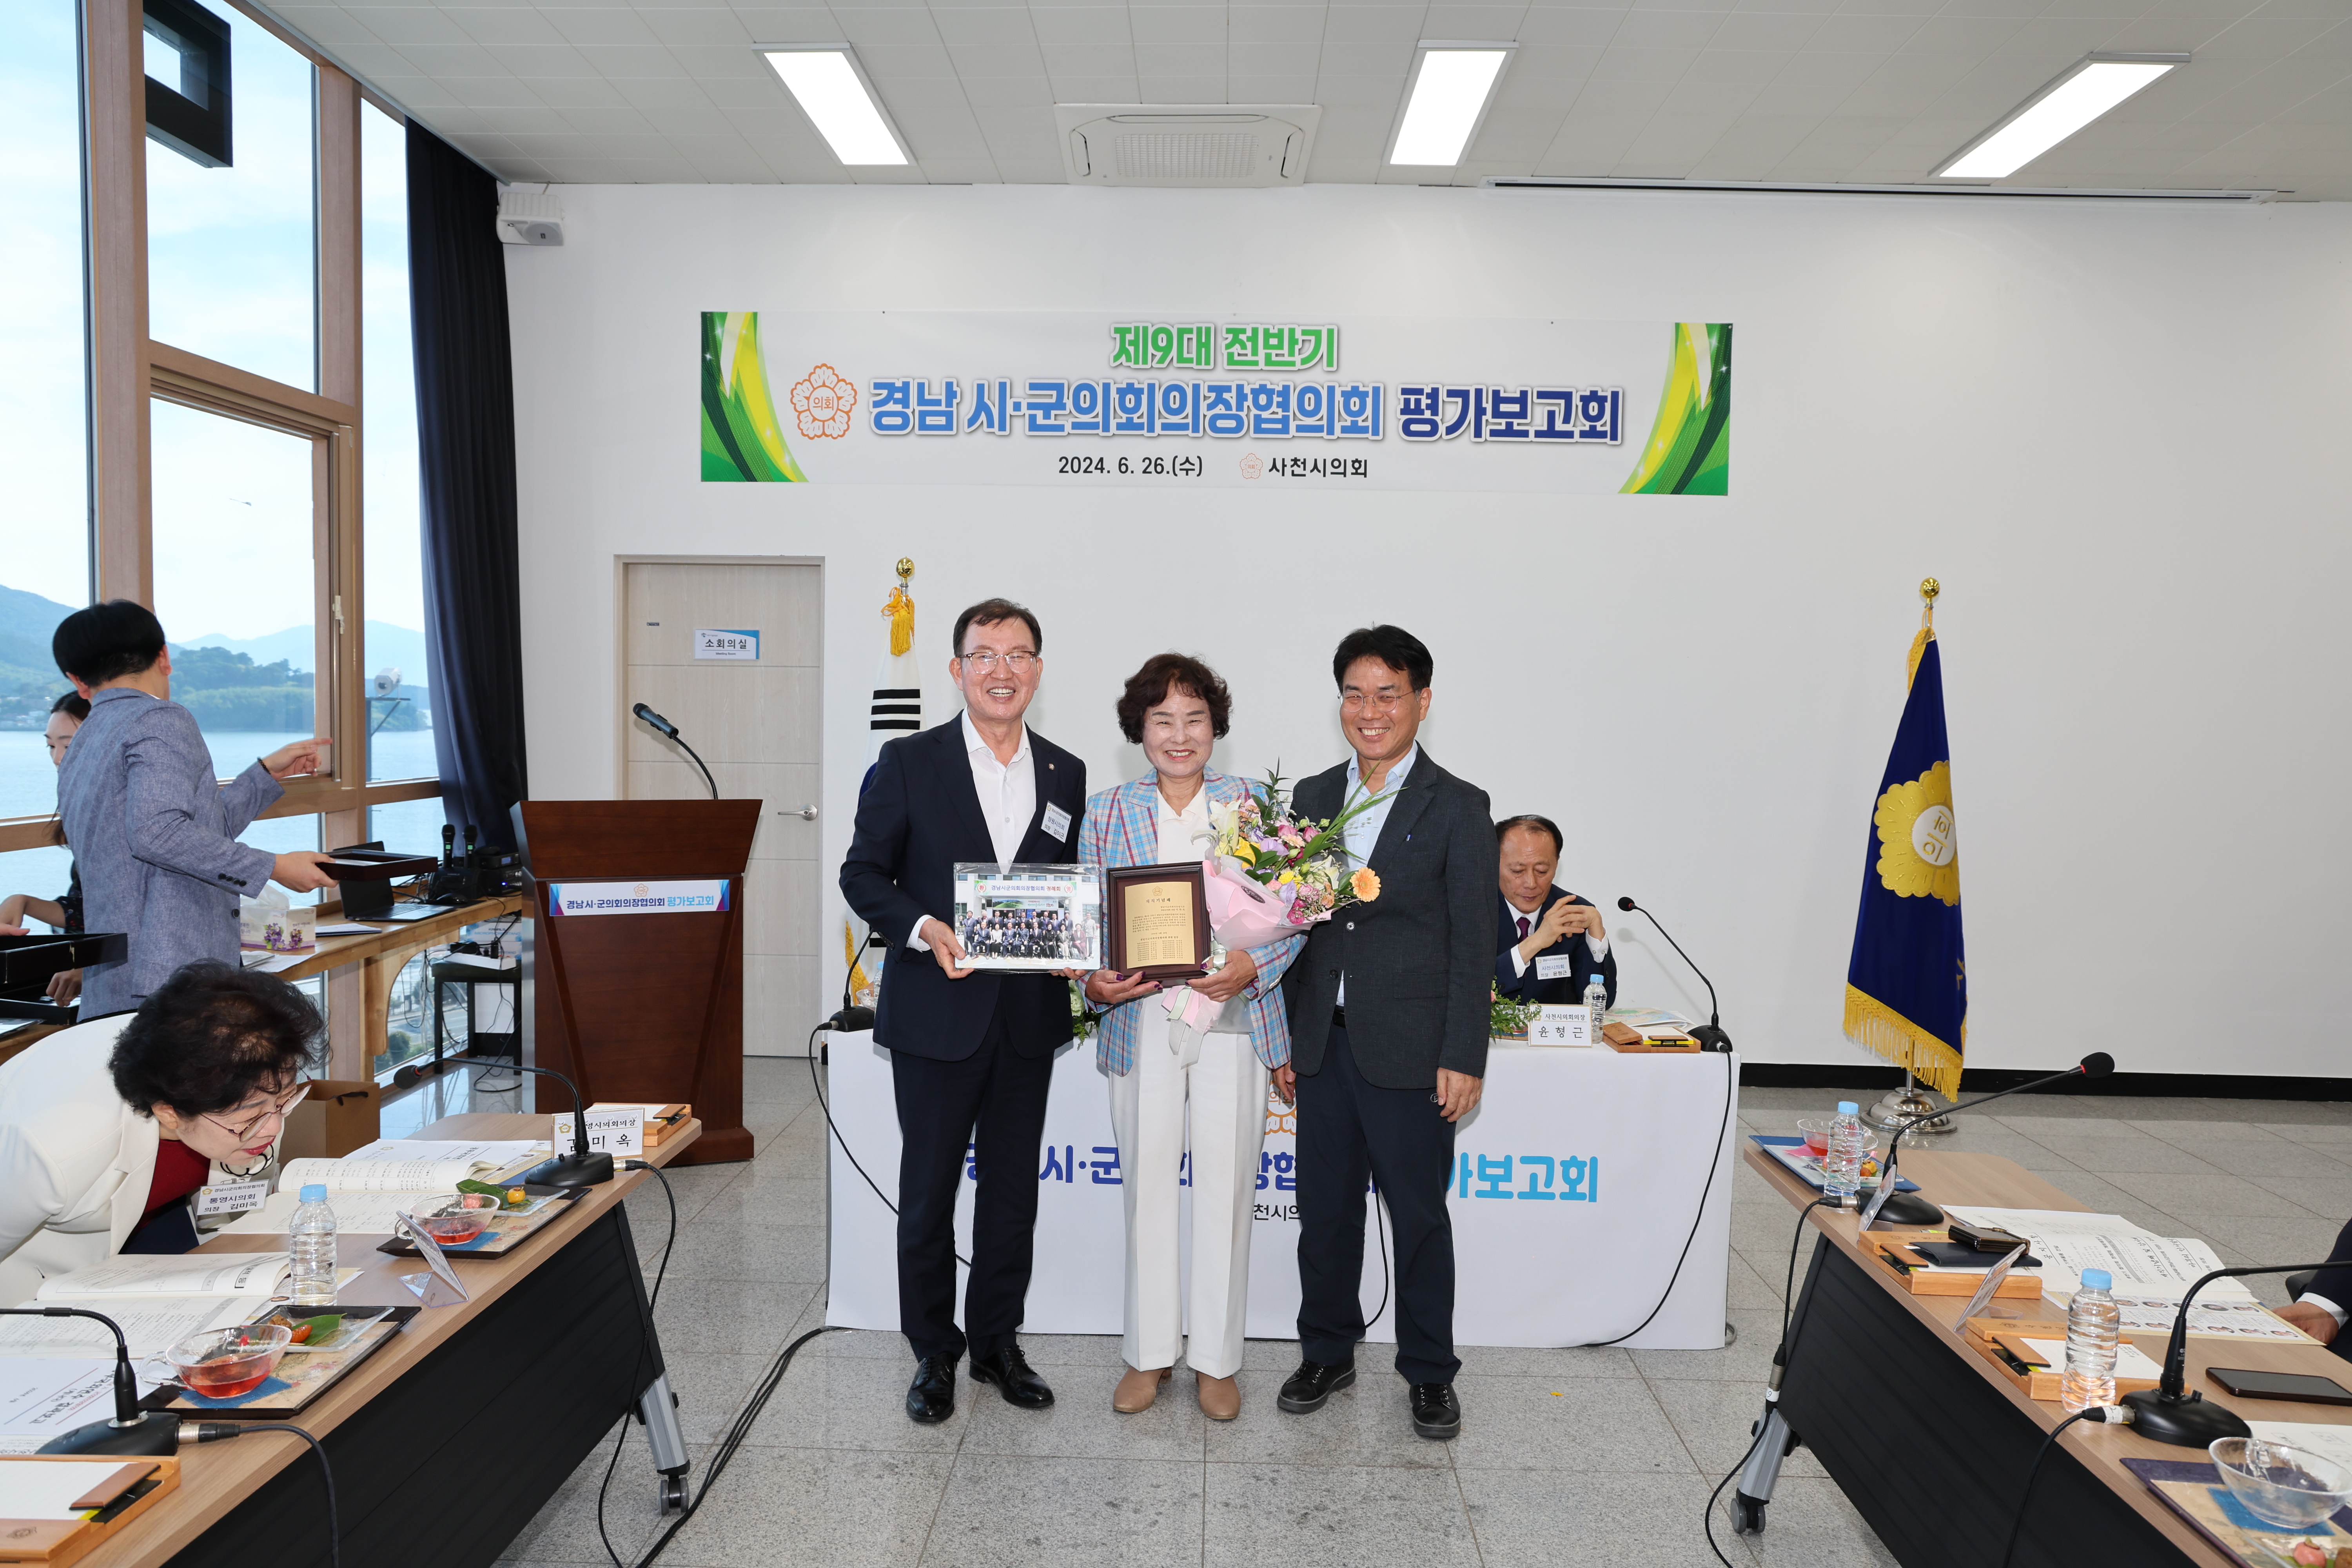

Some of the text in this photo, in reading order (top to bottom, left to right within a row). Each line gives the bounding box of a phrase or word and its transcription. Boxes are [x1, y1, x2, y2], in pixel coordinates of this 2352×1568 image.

[1112, 325, 1337, 370] 제9대 전반기
[813, 395, 835, 412] 의회
[871, 379, 1623, 444] 경남 시·군의회의장협의회 평가보고회
[1059, 455, 1203, 477] 2024. 6. 26.(수)
[1268, 457, 1368, 478] 사천시의회
[705, 638, 747, 650] 소회의실
[1048, 816, 1065, 831] 창원시의회
[1054, 828, 1064, 839] 김이근
[567, 895, 714, 909] 경남 시·군의회의장협의회 평가보고회
[586, 1119, 636, 1130] 영시의회의장
[214, 1183, 265, 1192] 경남시군의회의장협의회
[209, 1194, 256, 1204] 통영시의회
[230, 1201, 258, 1210] 김미옥
[2148, 1255, 2169, 1278] 재직기념패
[2181, 1254, 2196, 1268] 마무리
